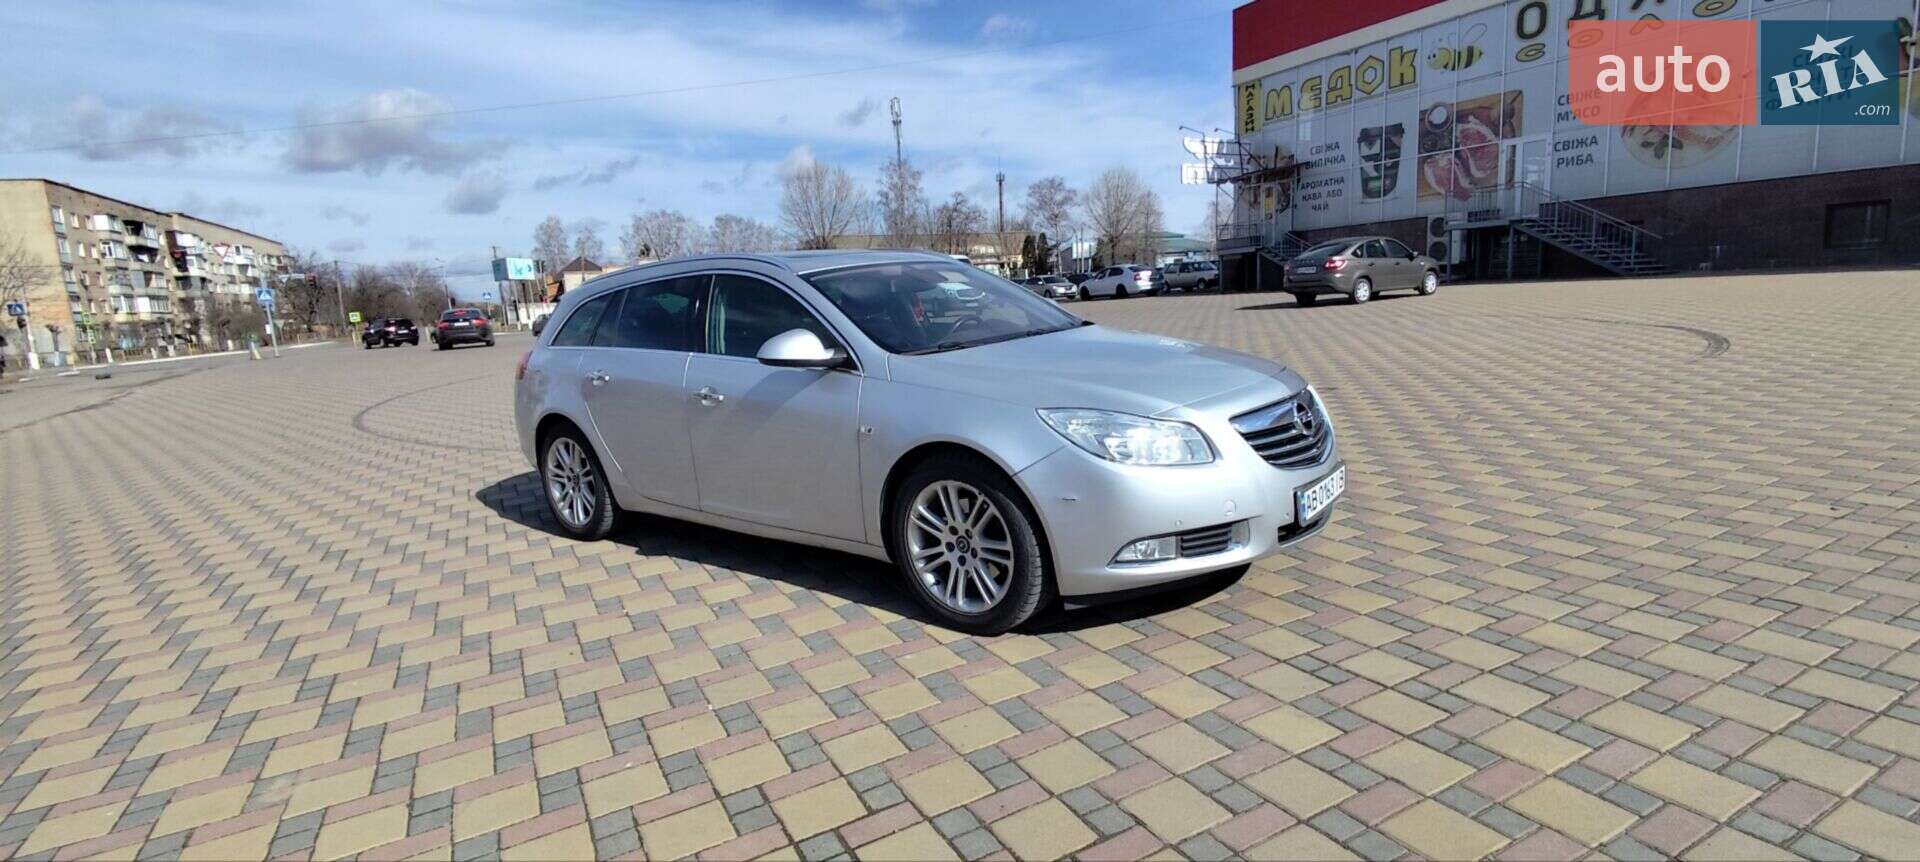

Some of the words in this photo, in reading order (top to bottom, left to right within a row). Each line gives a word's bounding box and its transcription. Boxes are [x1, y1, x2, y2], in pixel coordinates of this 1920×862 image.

[1264, 46, 1418, 121] МЕДОК
[1310, 141, 1340, 155] СВІЖА
[1554, 135, 1599, 152] СВІЖА
[1556, 153, 1594, 168] РИБА
[1302, 192, 1322, 202] КАВА
[1327, 189, 1343, 199] АБО
